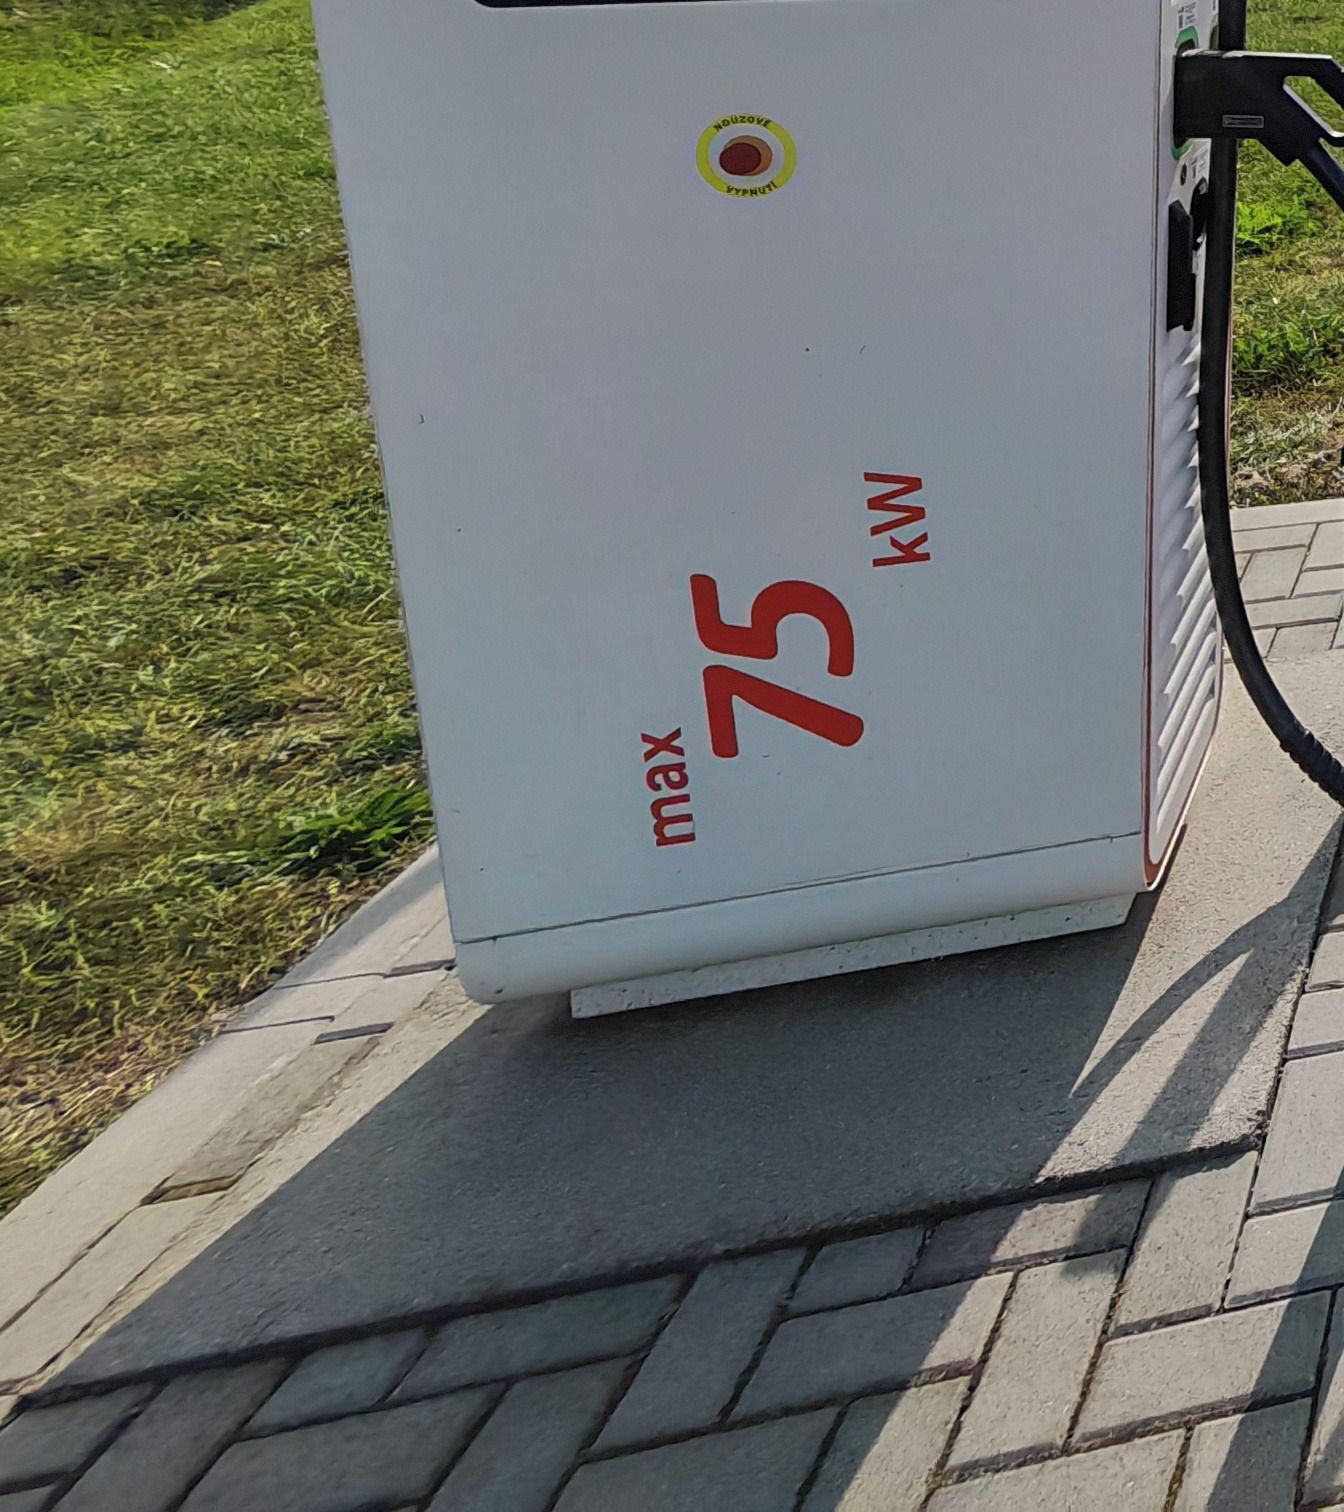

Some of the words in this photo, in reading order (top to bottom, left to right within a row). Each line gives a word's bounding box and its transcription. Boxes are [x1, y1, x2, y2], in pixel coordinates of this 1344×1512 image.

[641, 727, 696, 847] max
[690, 573, 864, 758] 75
[864, 472, 930, 567] kW
